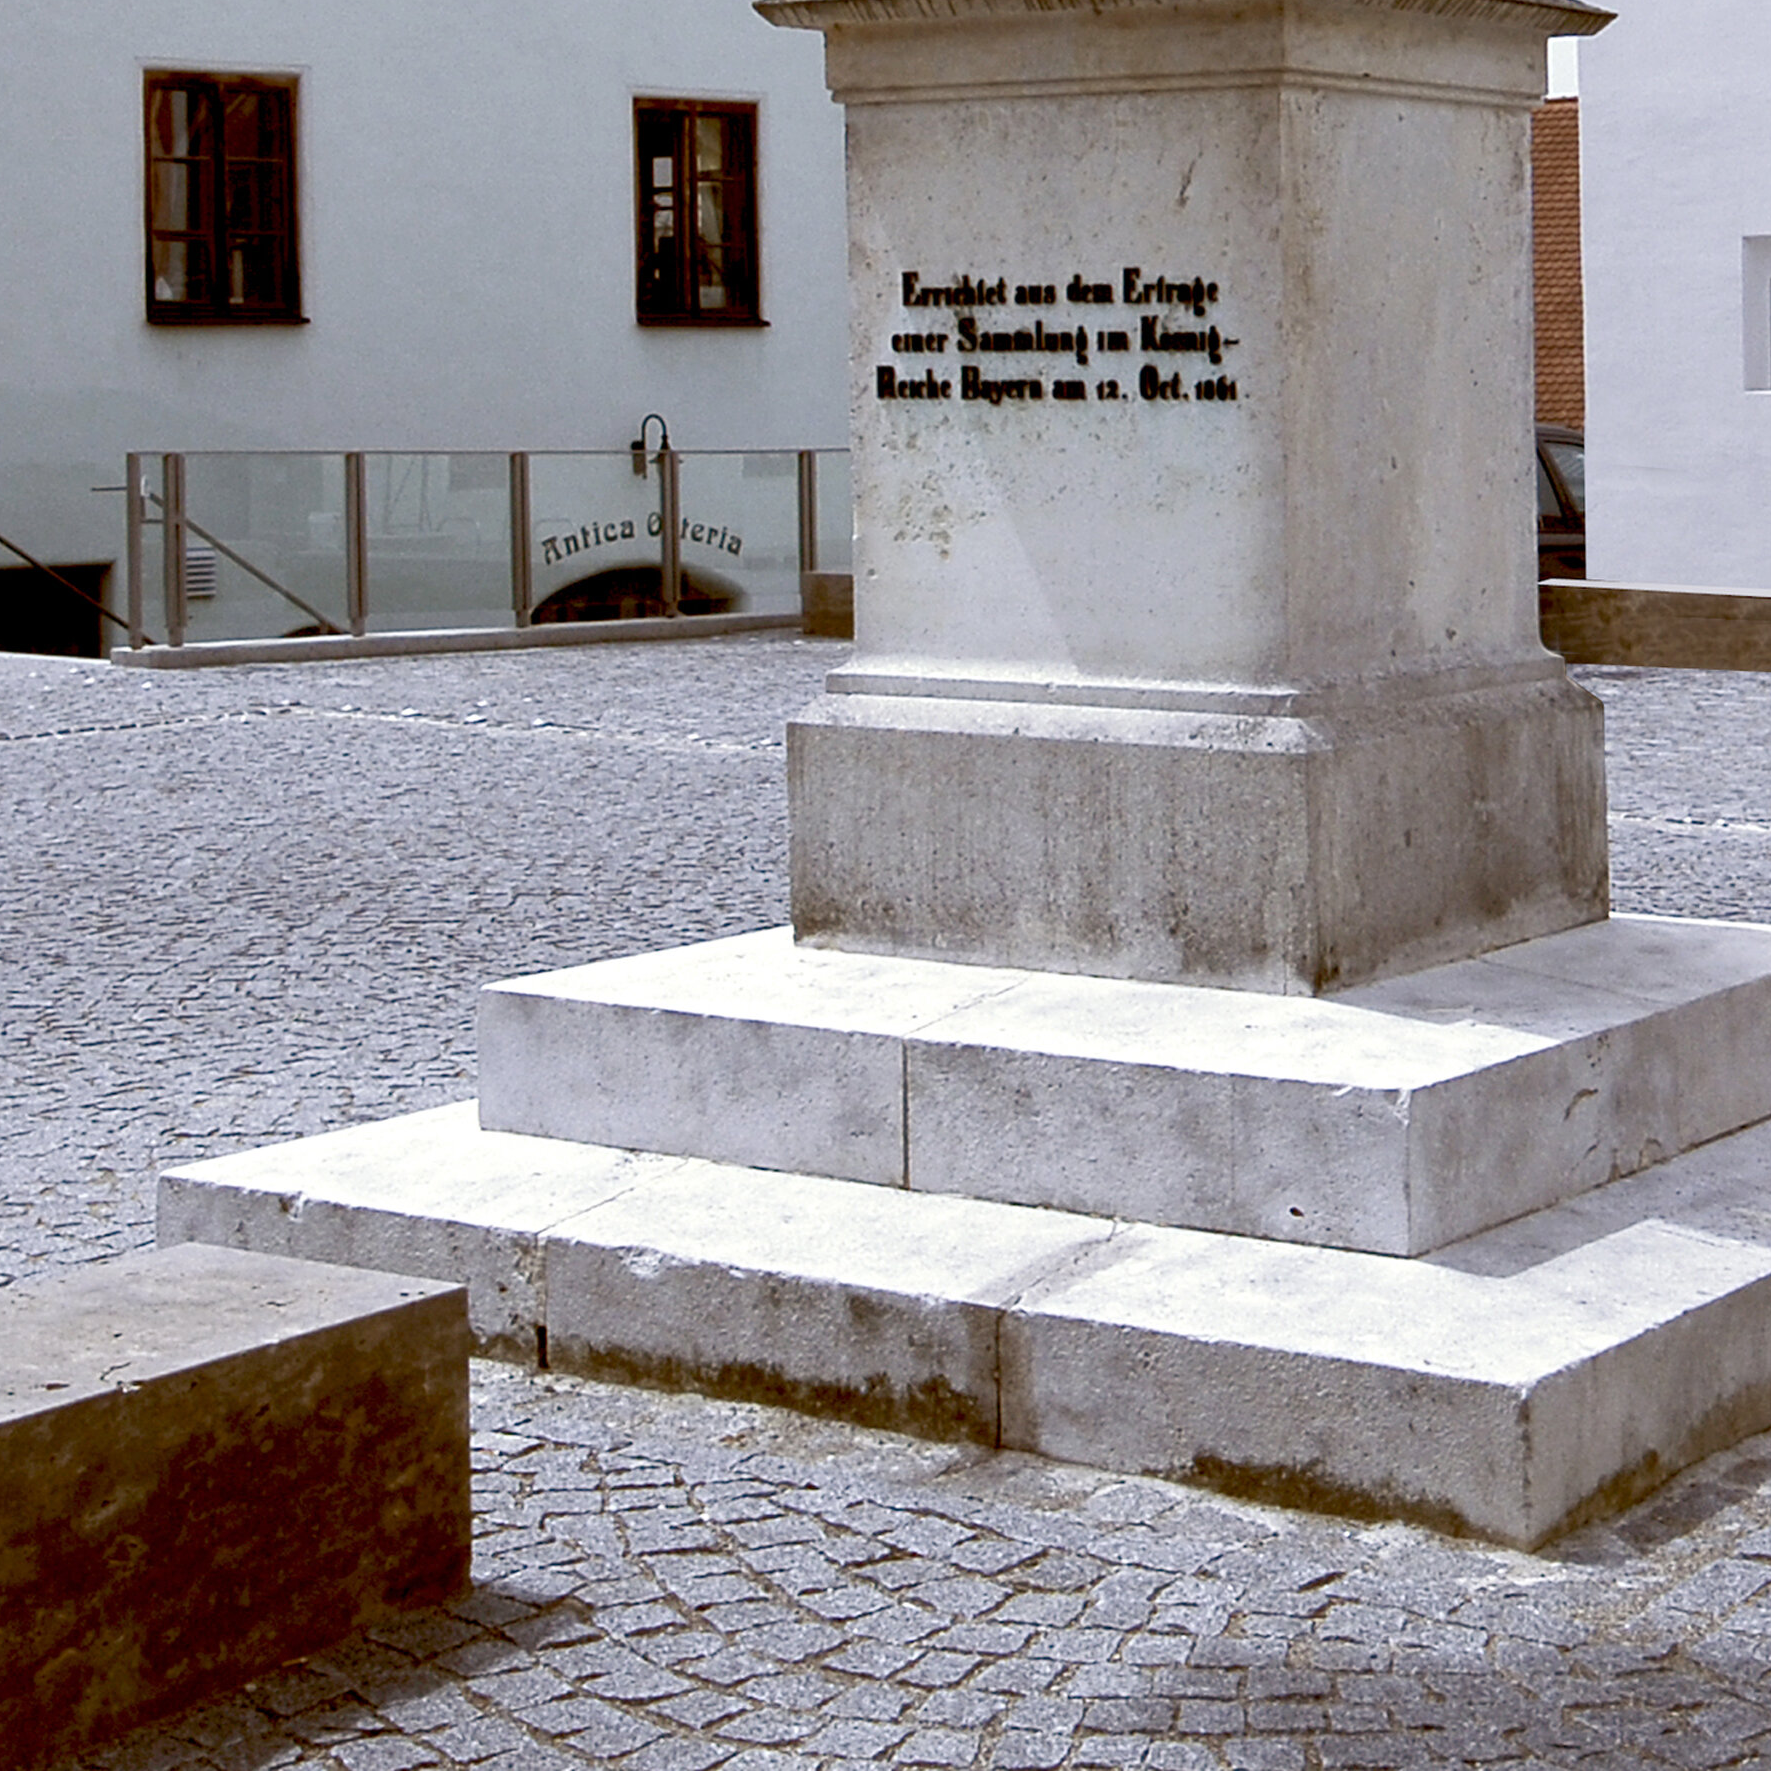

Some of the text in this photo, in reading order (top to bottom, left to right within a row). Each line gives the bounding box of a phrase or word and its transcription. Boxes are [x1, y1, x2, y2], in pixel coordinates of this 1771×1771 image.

[901, 267, 1219, 317] Errichtet aus dem Ertrage
[891, 332, 949, 353] einer
[956, 317, 1089, 366] Sammlung
[1097, 331, 1130, 352] im
[876, 365, 952, 400] Reiche
[960, 365, 1043, 406] Bayern
[1052, 379, 1087, 400] am
[1096, 379, 1128, 401] 12.
[1139, 364, 1189, 401] Oct.
[541, 512, 742, 565] Antica Oteria
